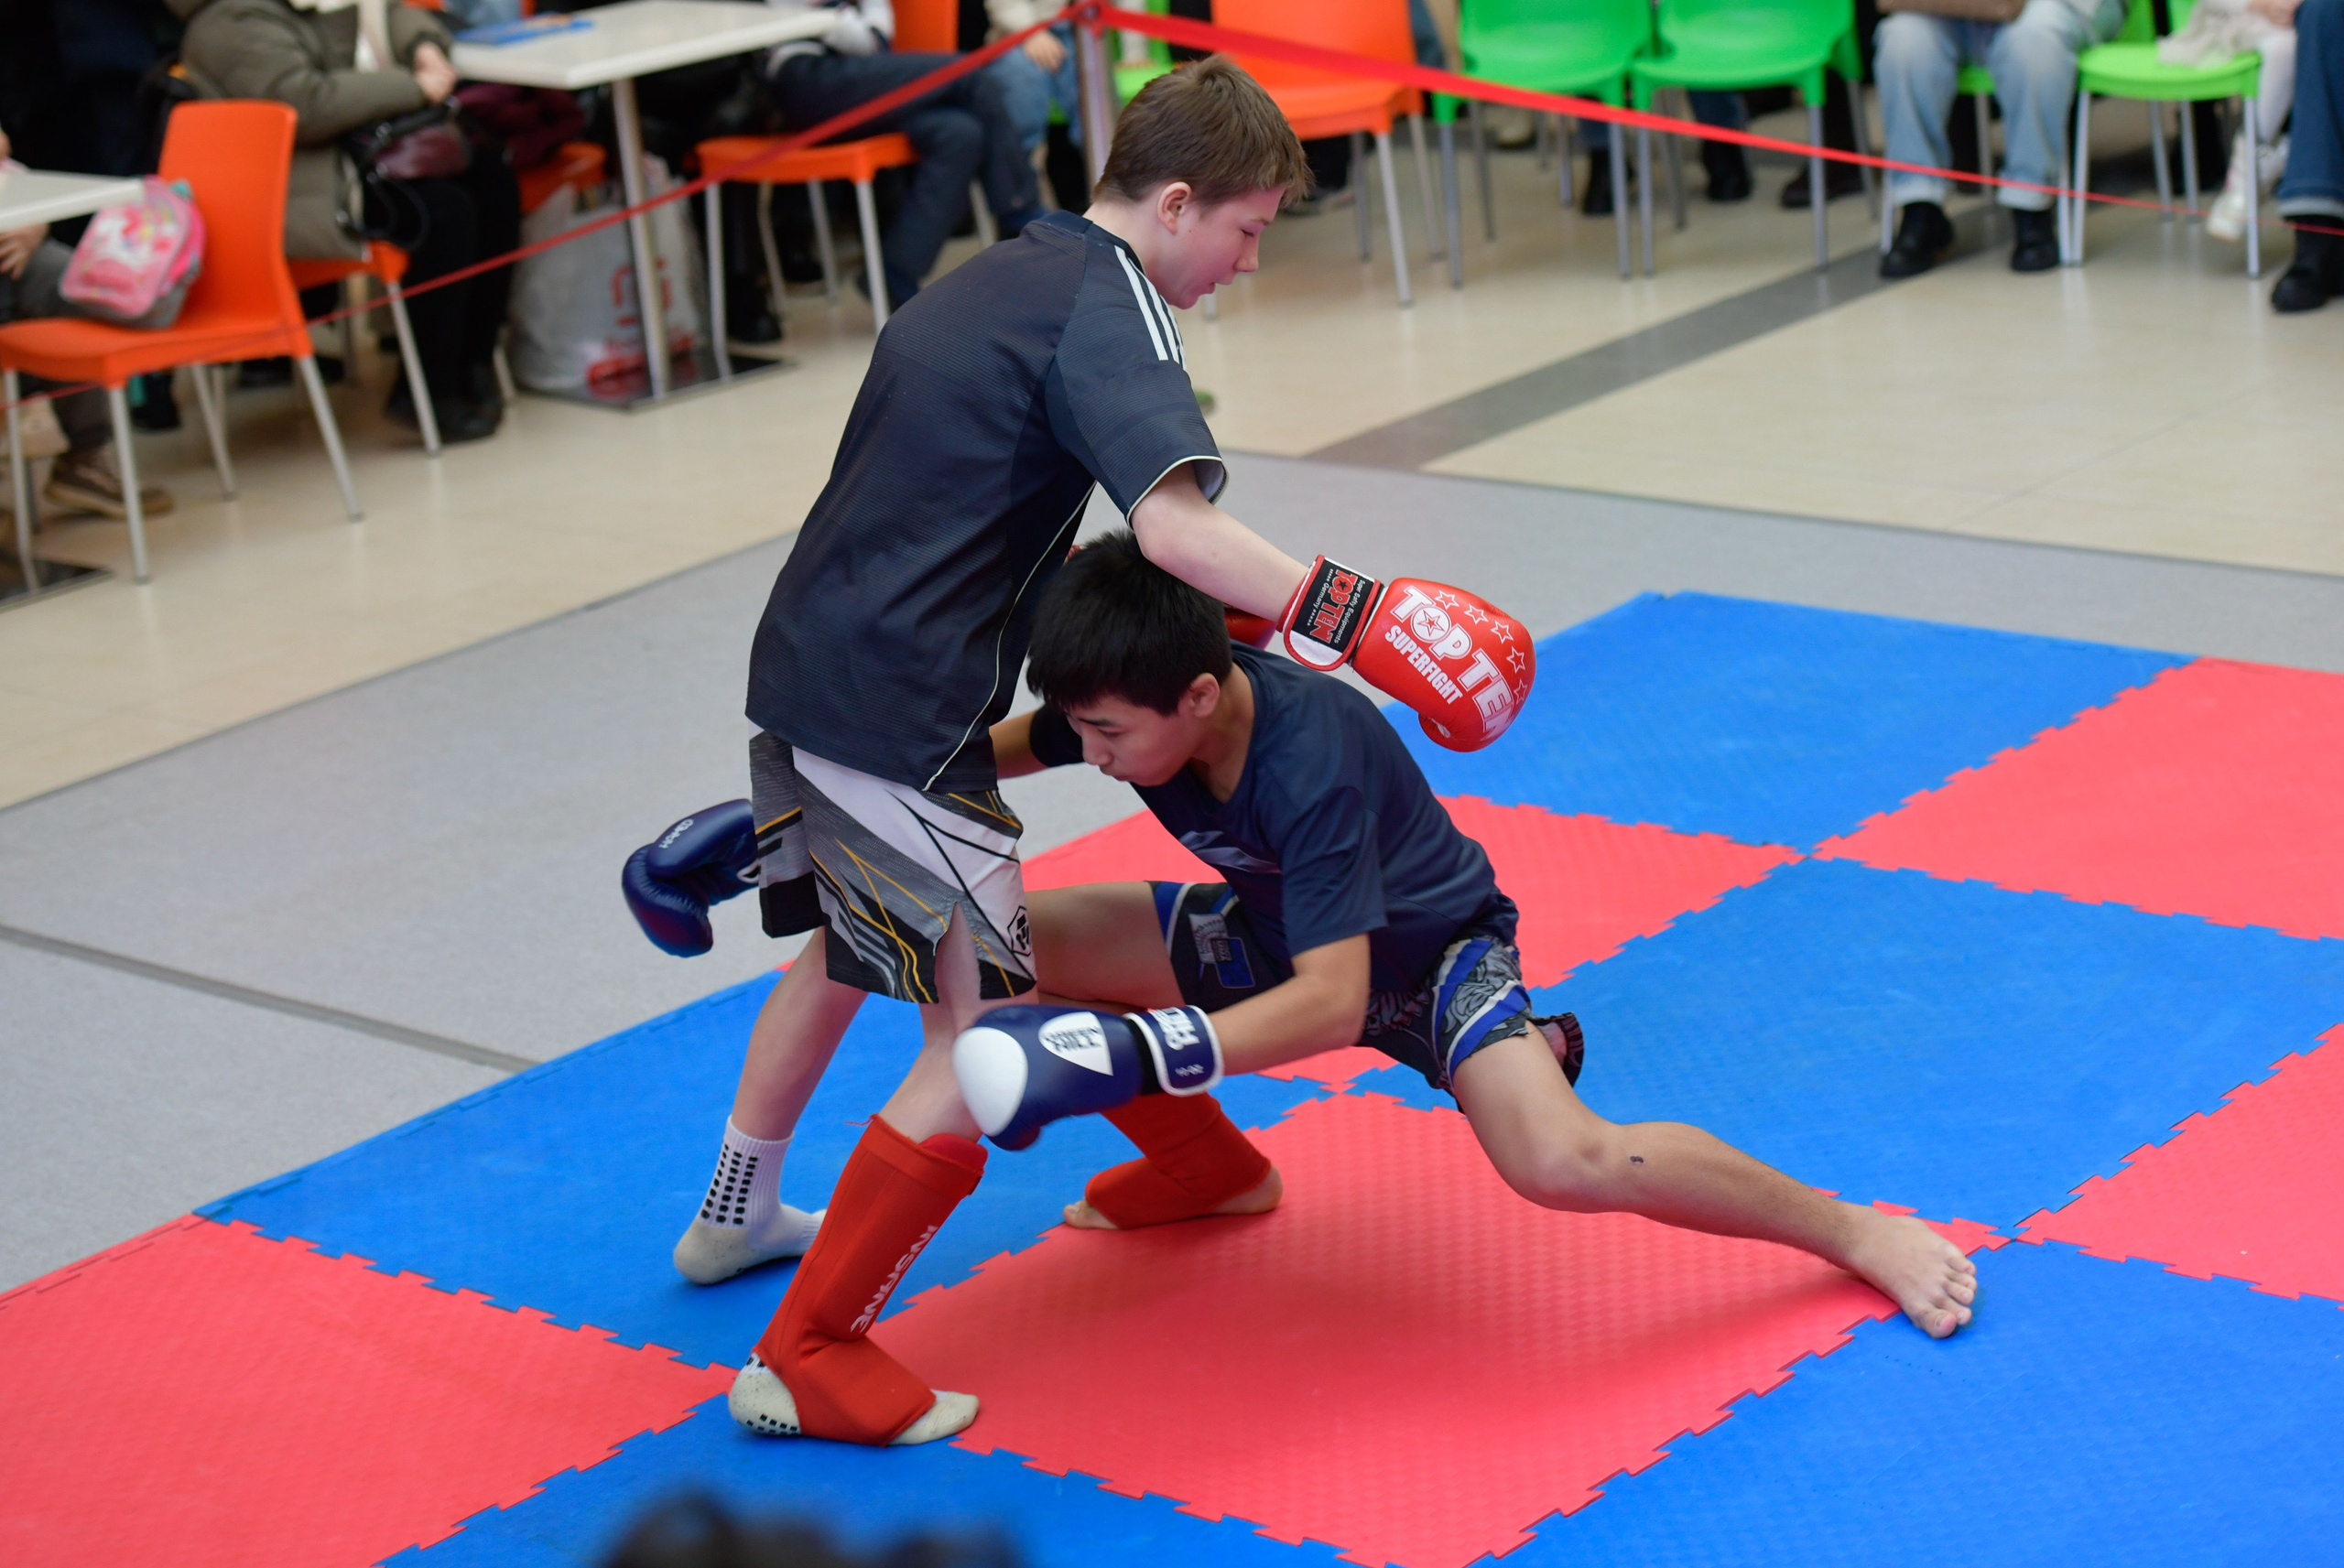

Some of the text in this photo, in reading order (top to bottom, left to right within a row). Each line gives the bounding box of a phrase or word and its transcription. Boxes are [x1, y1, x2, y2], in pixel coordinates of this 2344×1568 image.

[1309, 569, 1358, 643] TOP TEN
[1313, 582, 1329, 609] Germany
[1334, 608, 1354, 643] Equipments
[1390, 585, 1472, 661] TOP
[1384, 624, 1463, 705] SUPERFIGHT
[850, 1225, 939, 1334] INSANE
